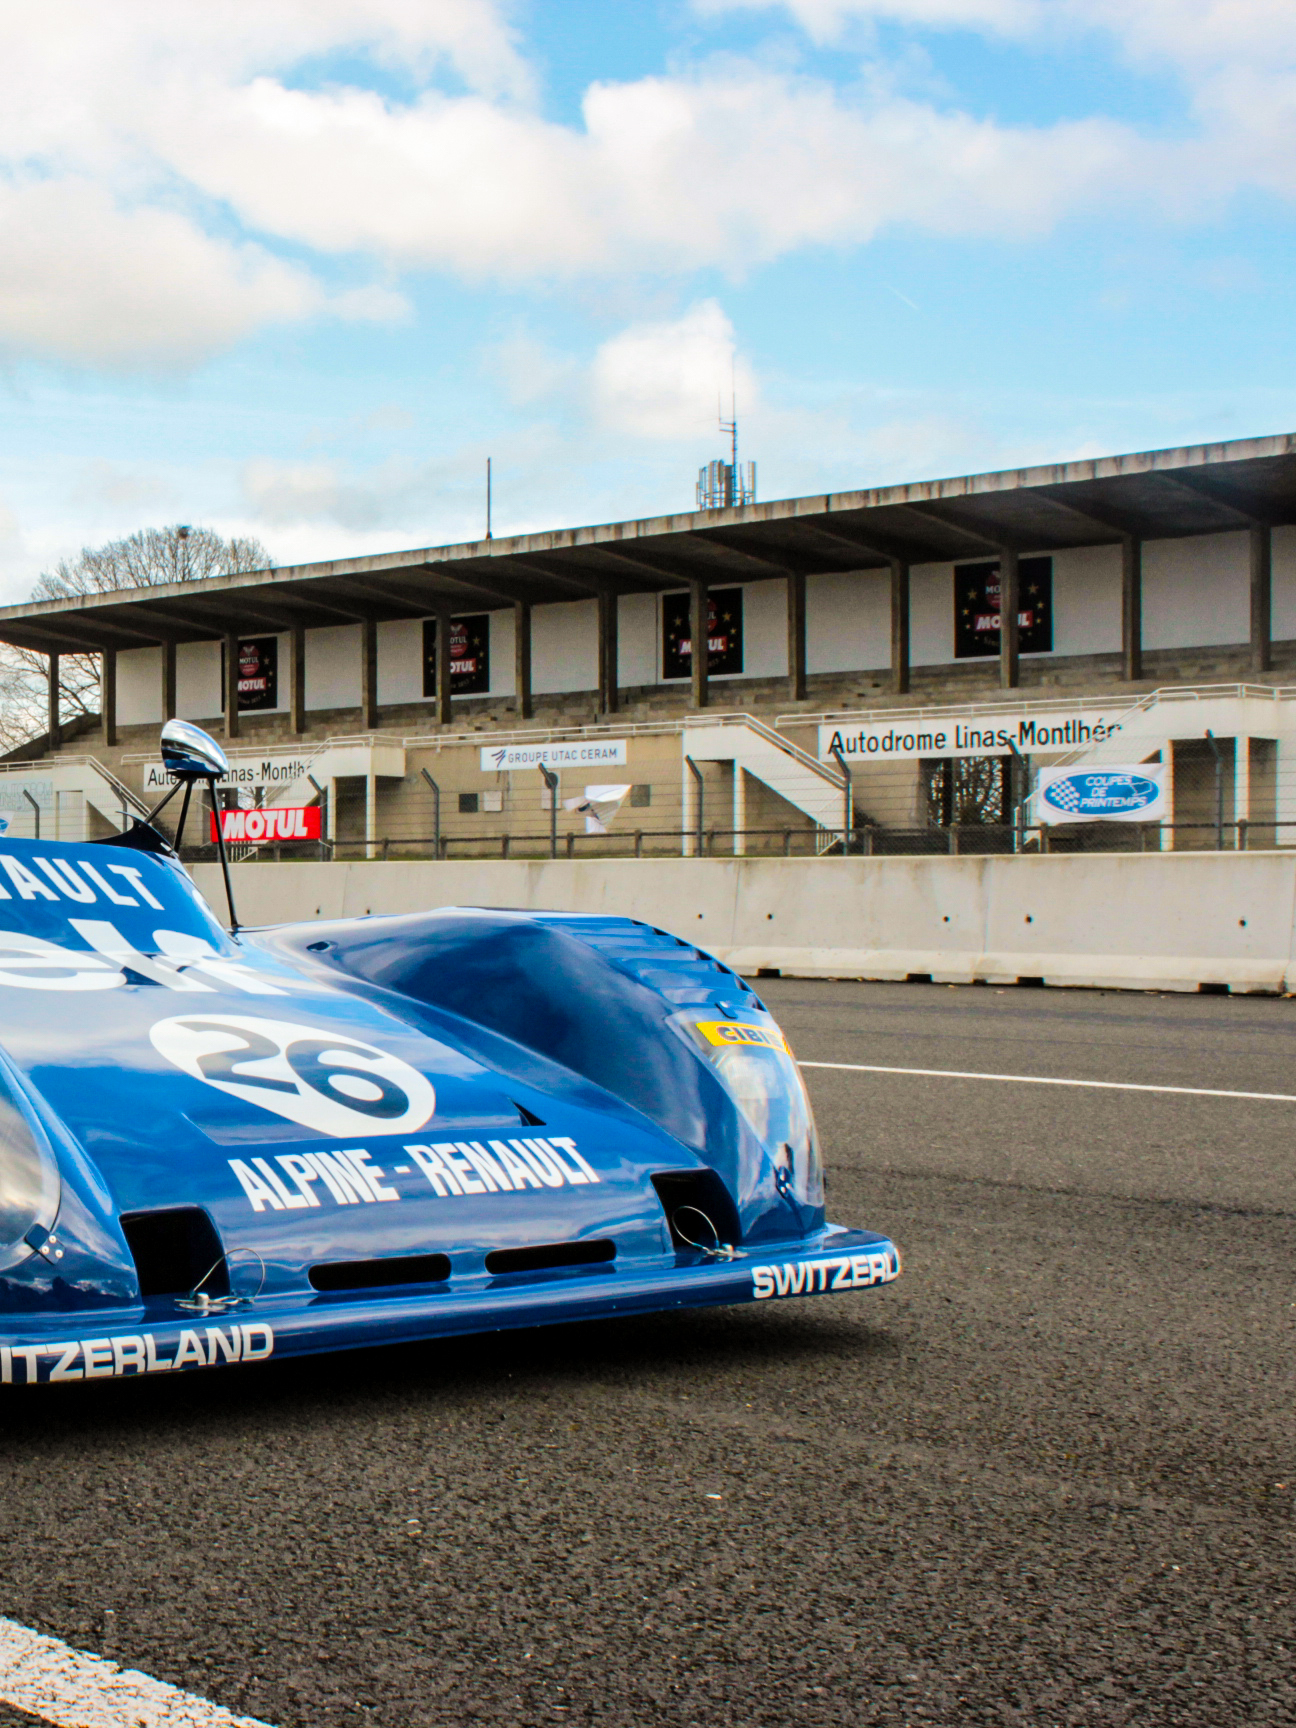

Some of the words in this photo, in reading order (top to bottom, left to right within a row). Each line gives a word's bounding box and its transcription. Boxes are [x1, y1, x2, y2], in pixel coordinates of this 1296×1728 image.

[976, 613, 1030, 630] MOL
[449, 636, 467, 644] OTUL
[680, 638, 724, 654] MUL
[450, 661, 474, 673] OTUL
[827, 730, 946, 754] Autodrome
[508, 751, 548, 763] GROUPE
[551, 750, 578, 761] UTAC
[581, 747, 617, 759] CERAM
[1085, 776, 1132, 787] COUPES
[1091, 787, 1108, 797] DE
[1080, 796, 1148, 808] PRINTEMPS
[223, 810, 308, 839] MOTUL
[174, 1021, 410, 1119] 26
[227, 1148, 400, 1212] ALPINE
[403, 1136, 600, 1197] RENAULT
